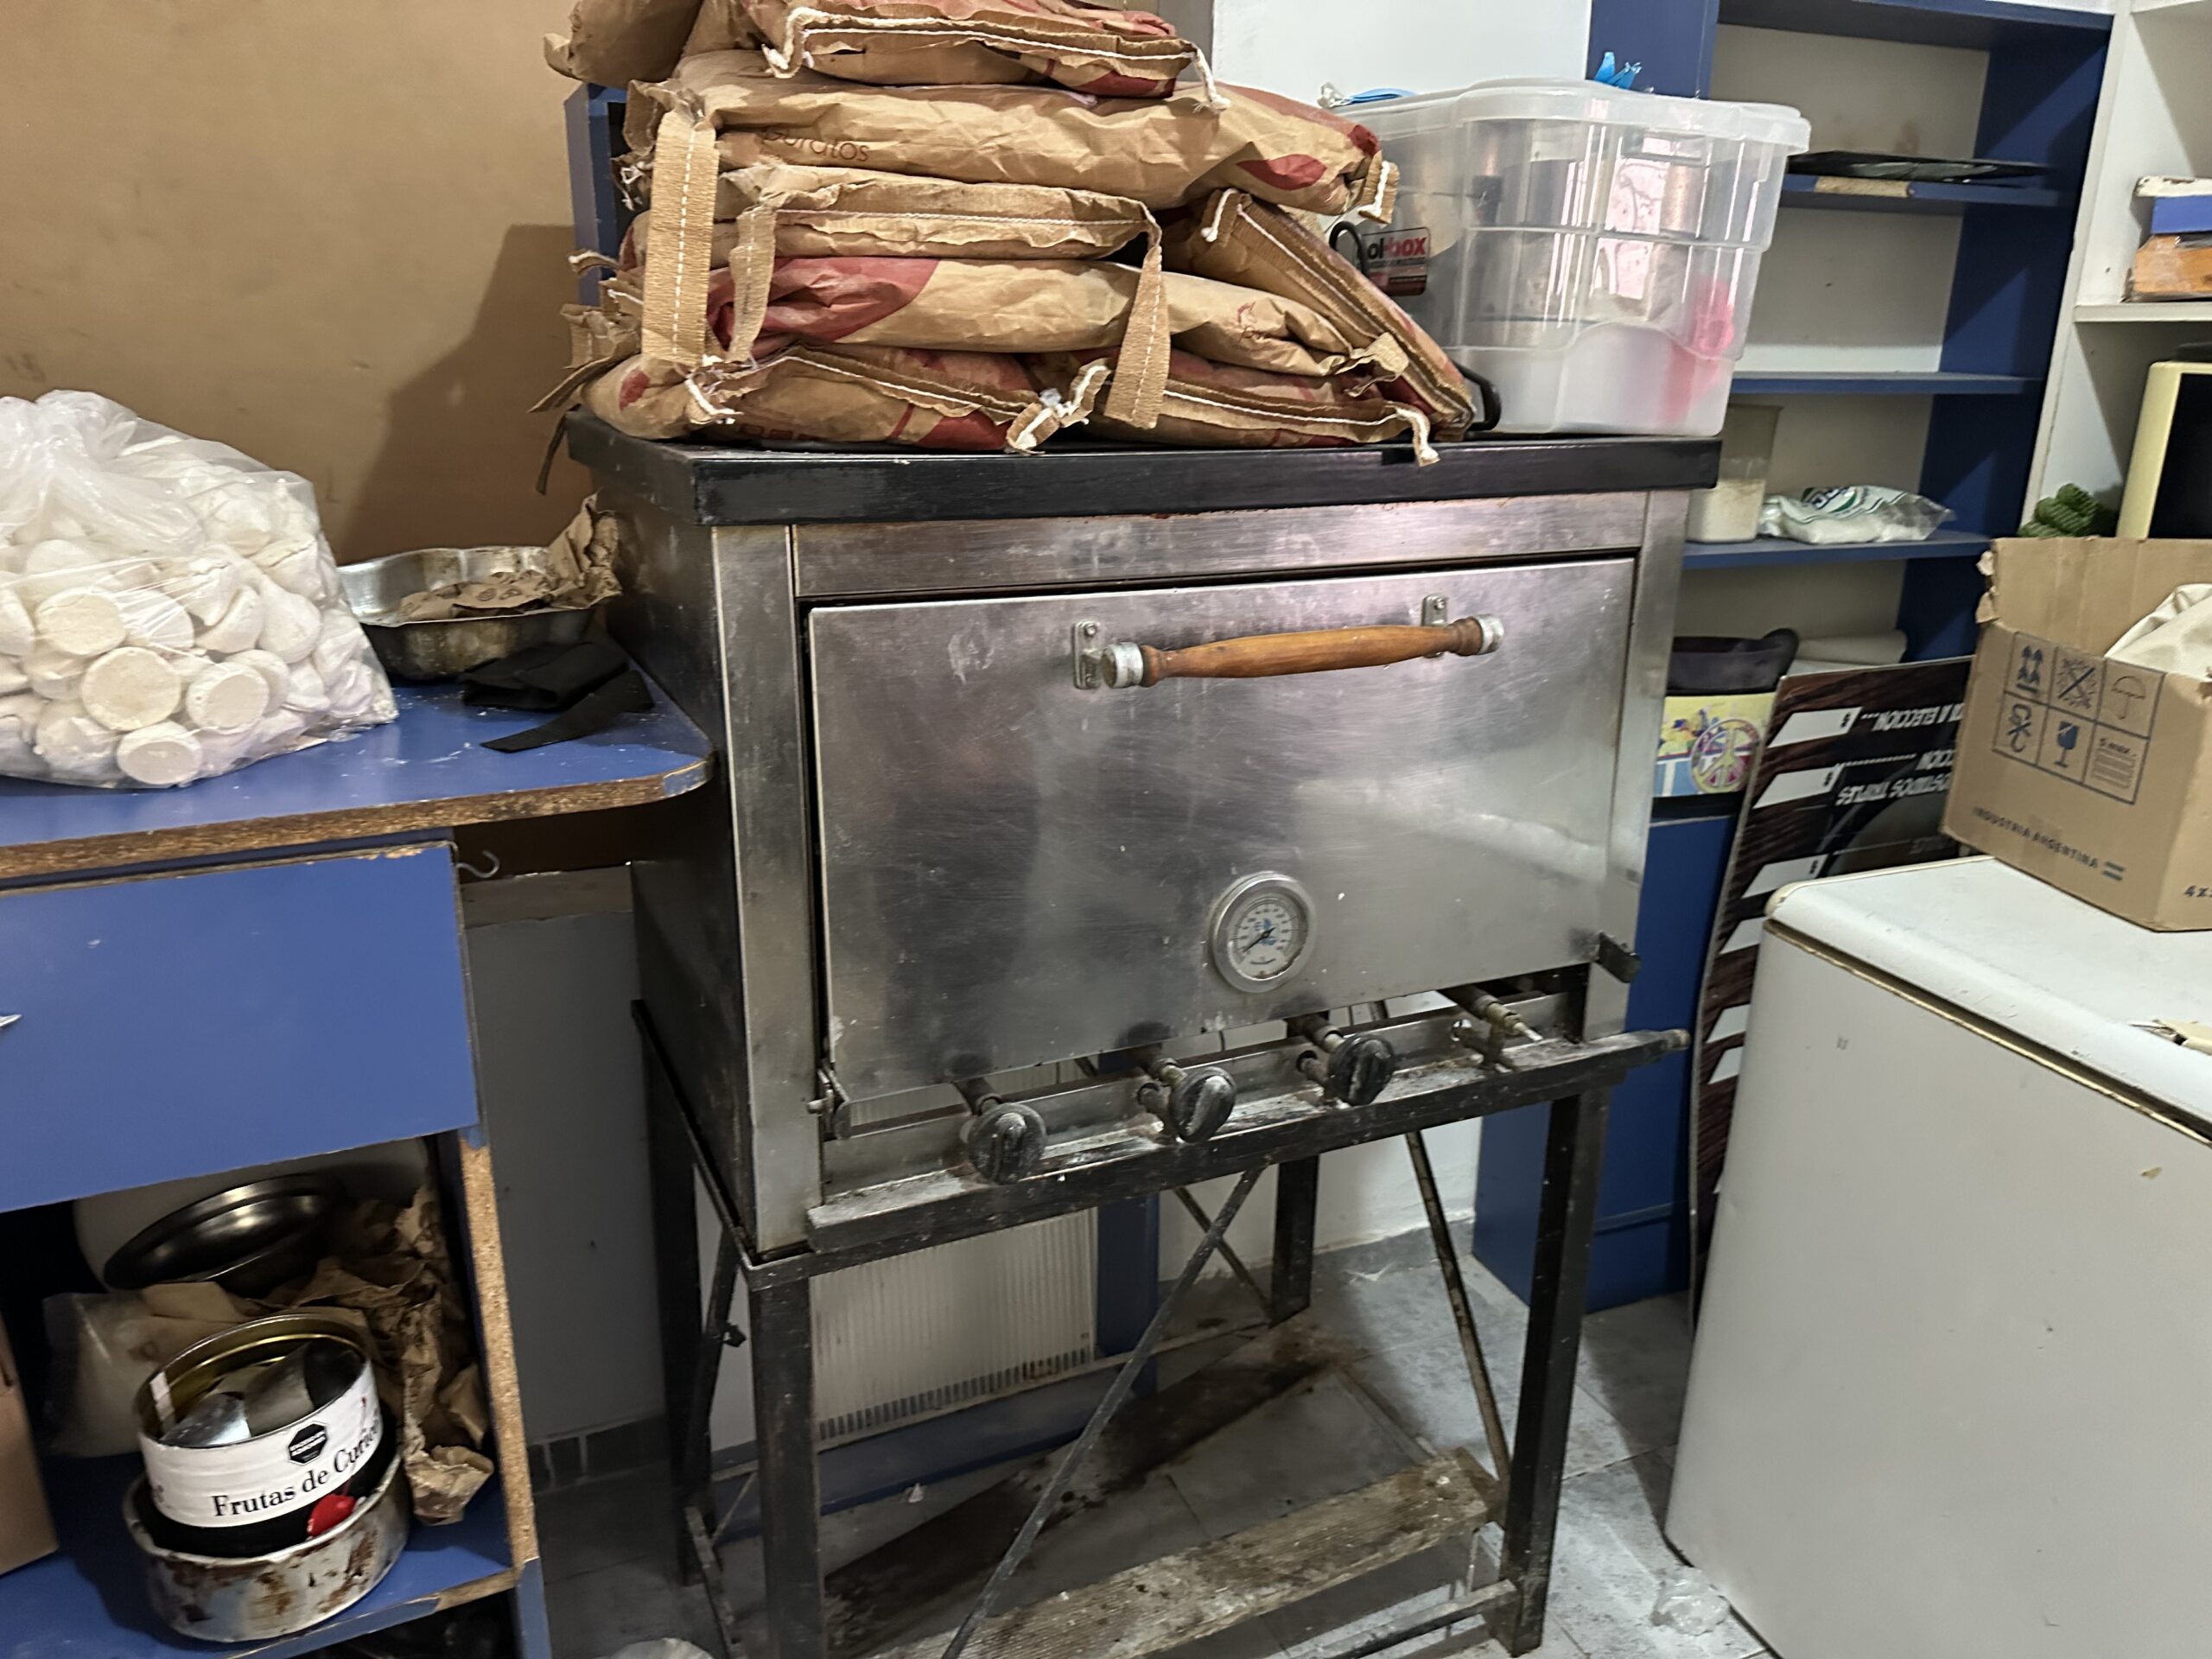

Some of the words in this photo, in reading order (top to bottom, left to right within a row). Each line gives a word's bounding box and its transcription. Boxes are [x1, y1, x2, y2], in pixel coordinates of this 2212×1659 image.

[2031, 831, 2099, 869] ARGENTINA
[212, 1486, 296, 1517] Frutas
[302, 1470, 328, 1493] de
